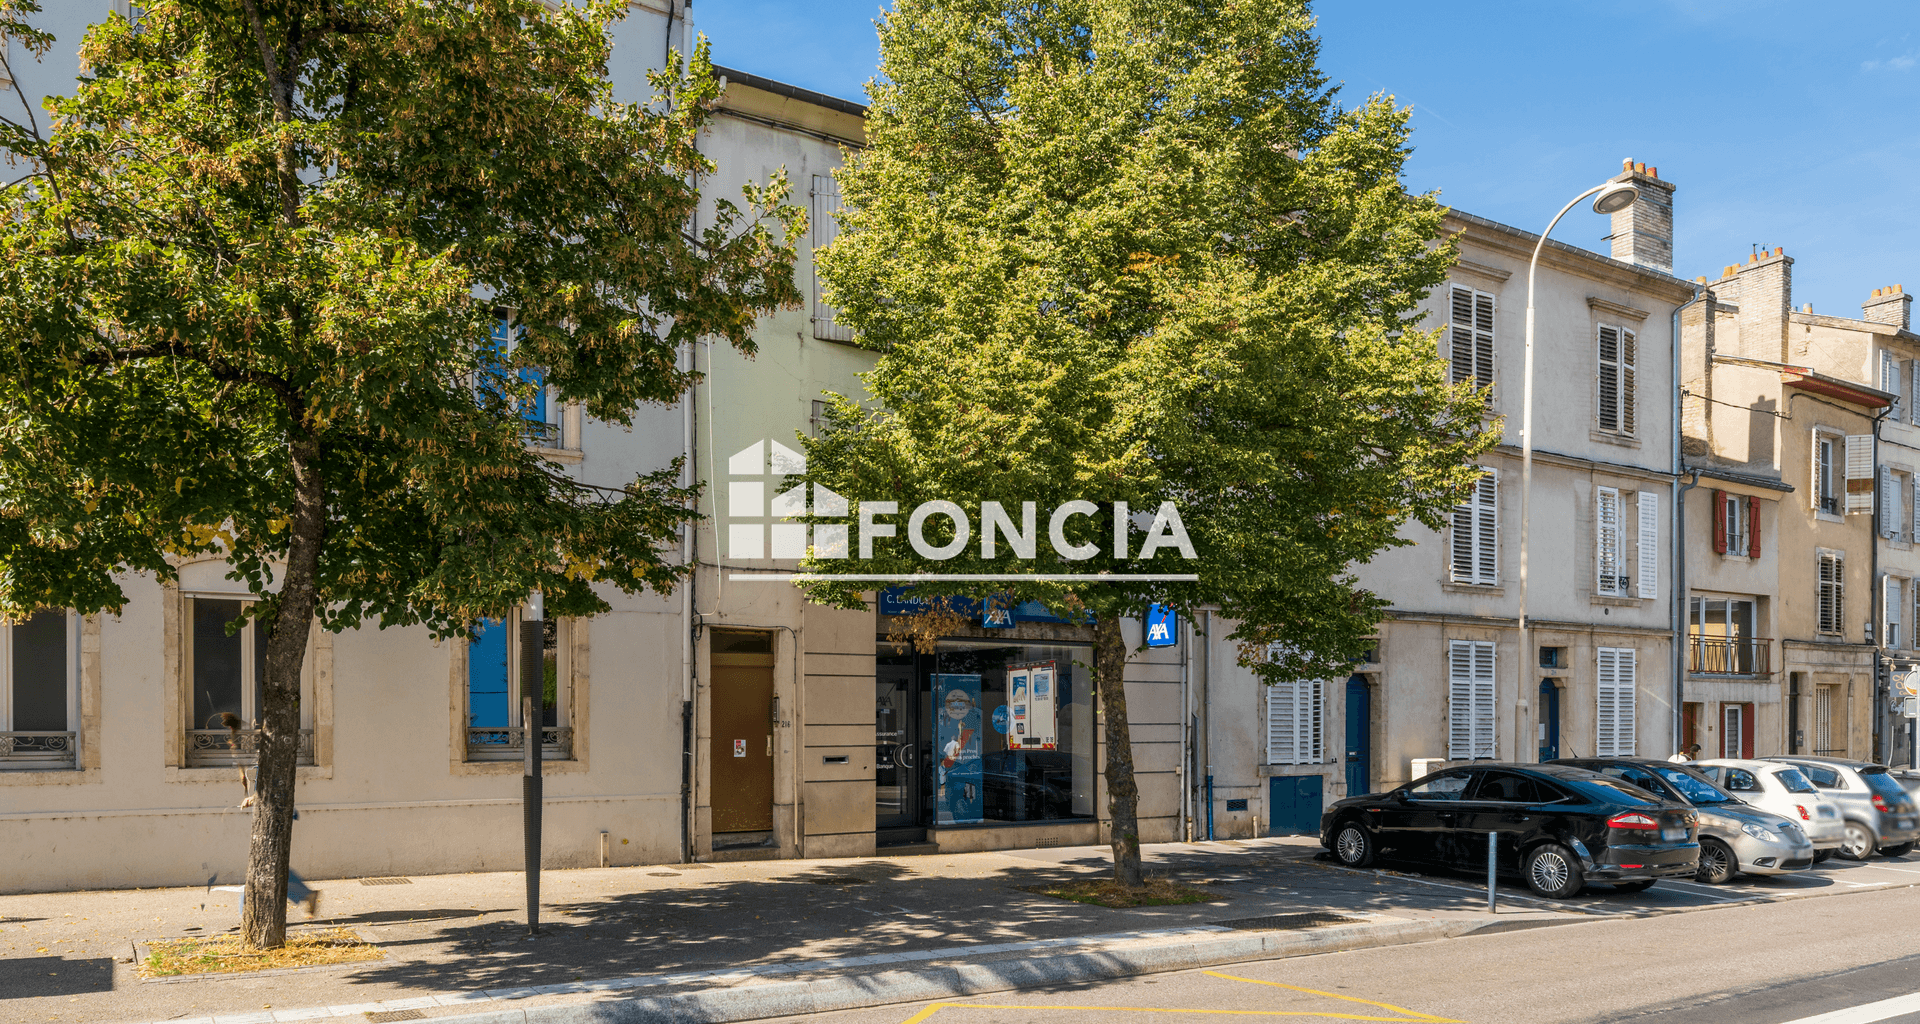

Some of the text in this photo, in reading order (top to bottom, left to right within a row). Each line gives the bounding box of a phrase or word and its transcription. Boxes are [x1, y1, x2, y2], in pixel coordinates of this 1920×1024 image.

[886, 594, 895, 604] C.
[985, 609, 1012, 625] AXA
[1147, 623, 1169, 640] AXA
[876, 696, 892, 706] AXA
